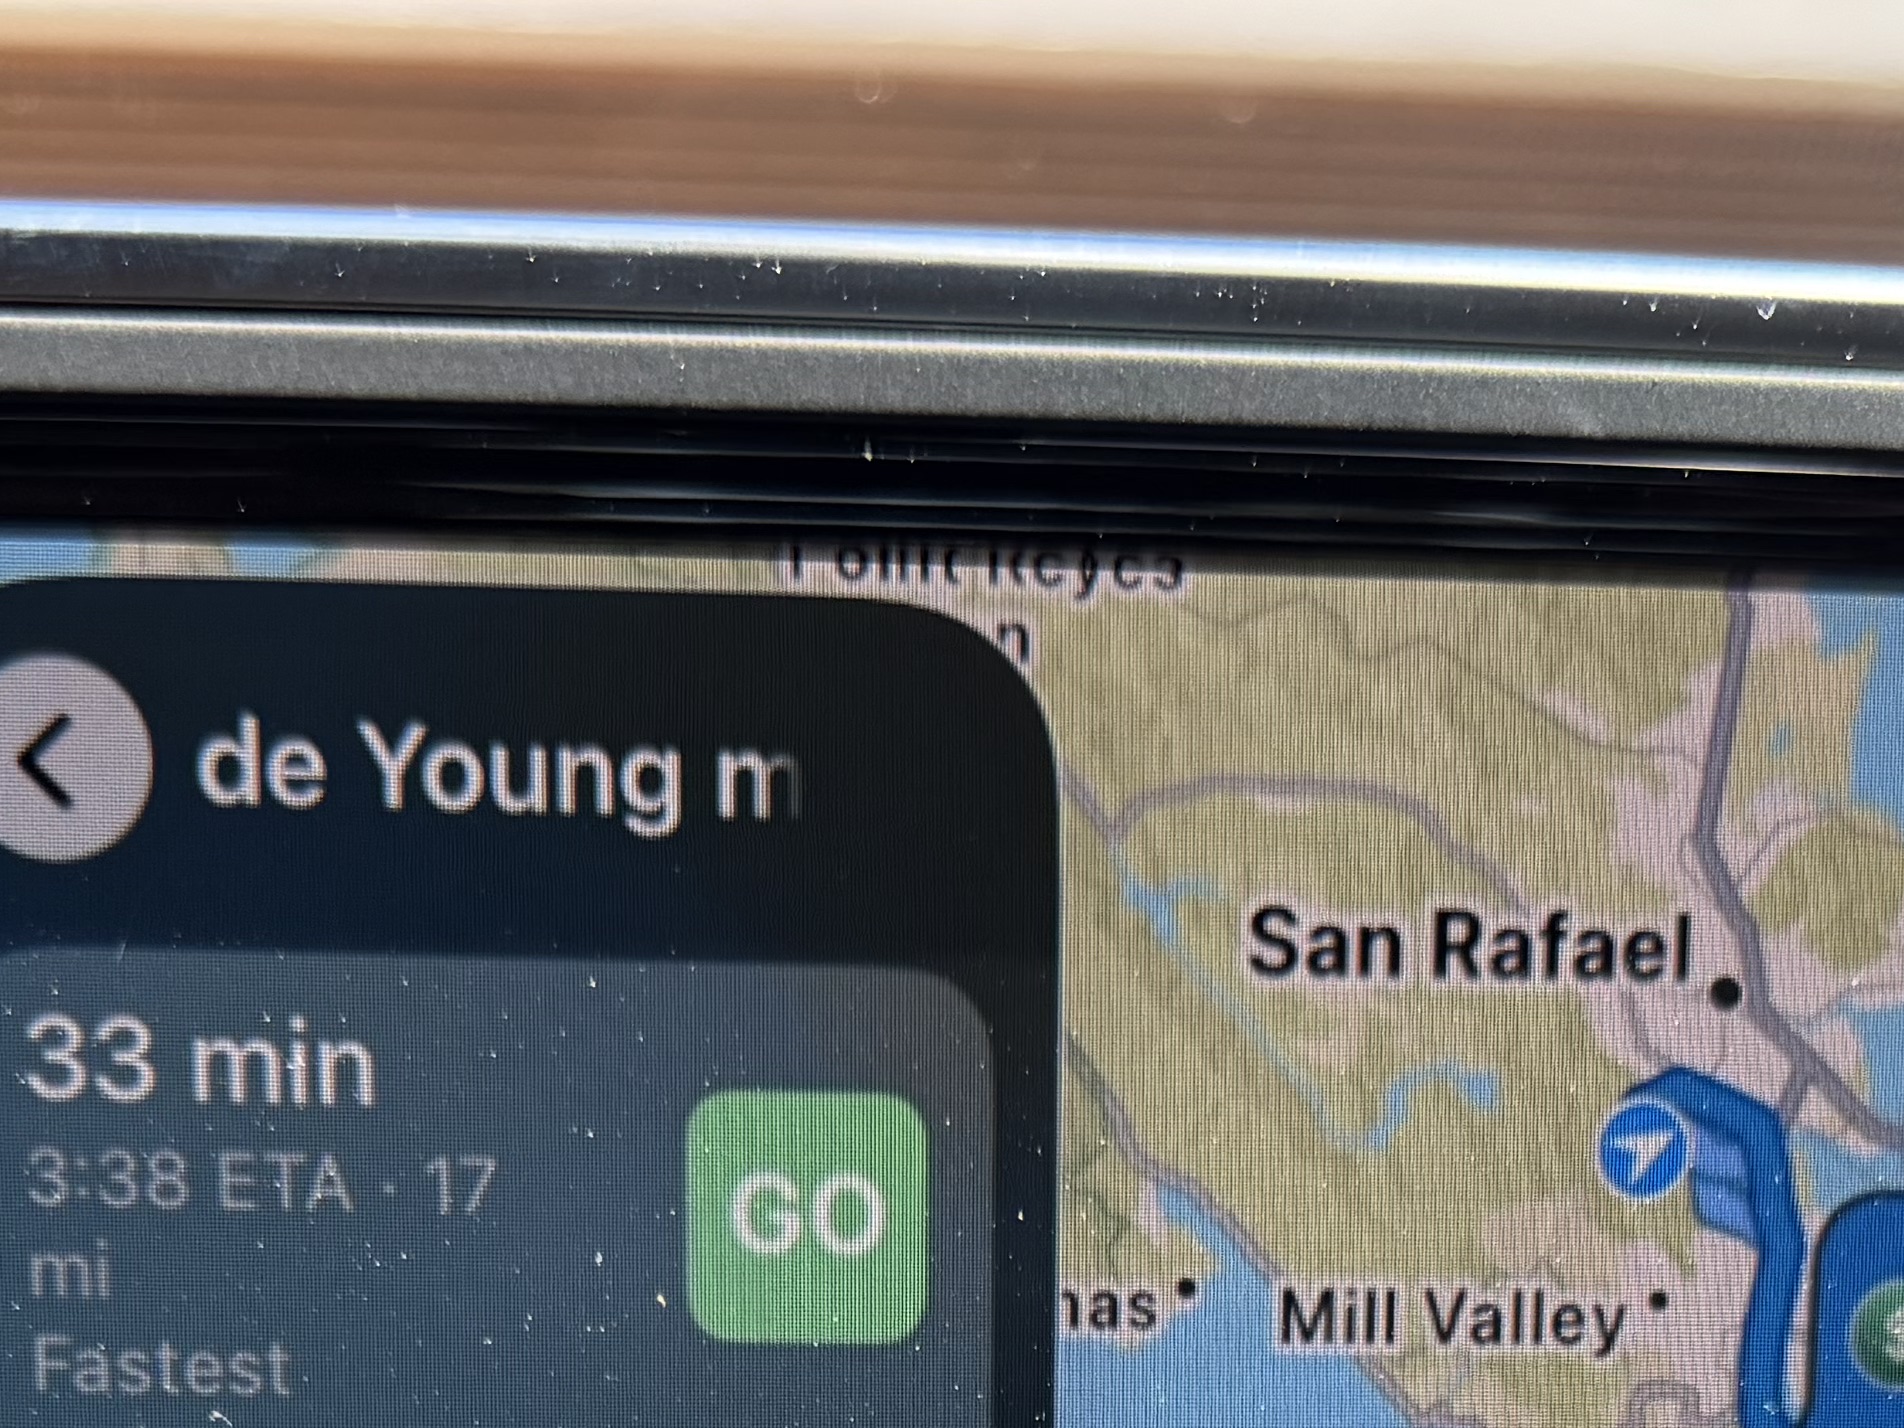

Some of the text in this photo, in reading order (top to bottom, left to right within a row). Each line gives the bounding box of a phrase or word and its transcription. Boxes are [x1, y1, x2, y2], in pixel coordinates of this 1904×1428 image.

[197, 710, 328, 809] de
[356, 716, 683, 838] Young
[1249, 905, 1693, 983] San Rafael
[26, 1014, 377, 1105] 33 min
[26, 1148, 497, 1215] 3:38 ETA 17
[731, 1170, 887, 1258] GO
[30, 1238, 111, 1299] mi
[1279, 1286, 1628, 1359] Mill Valley
[34, 1332, 293, 1397] Fastest
